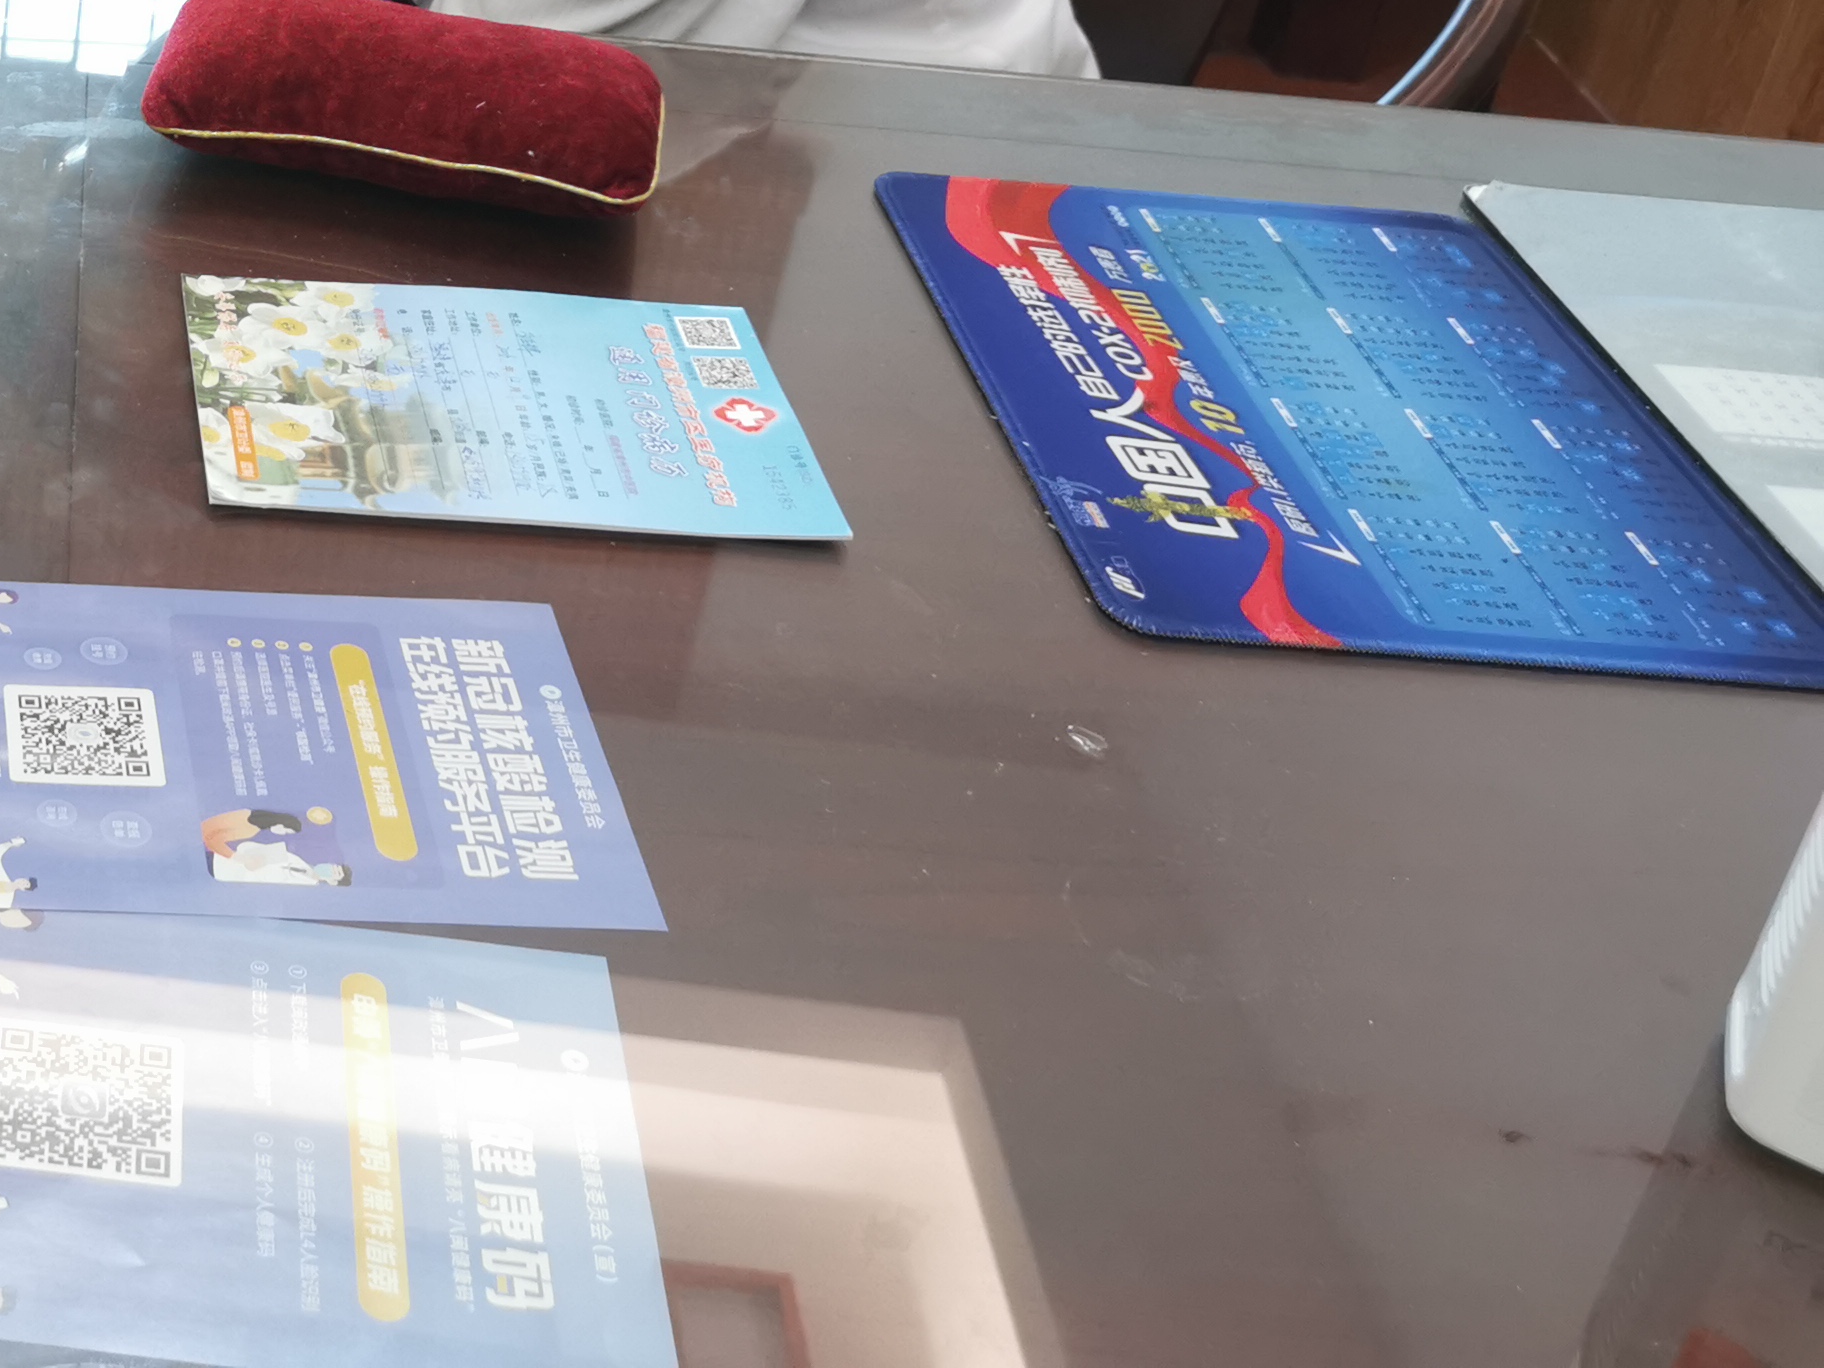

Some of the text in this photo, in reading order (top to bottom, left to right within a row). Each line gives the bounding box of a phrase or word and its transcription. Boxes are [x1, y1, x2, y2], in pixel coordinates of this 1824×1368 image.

[993, 263, 1121, 399] 自己的选择性
[1027, 245, 1156, 380] COX-2抑制剂
[1110, 288, 1186, 349] 2000
[1124, 248, 1167, 281] 2021
[604, 345, 691, 478] 通用门诊病历
[1089, 386, 1240, 538] 中国人
[1185, 398, 1245, 434] 10
[397, 635, 515, 878] 在线预约服务平台
[450, 638, 579, 880] 新冠核酸检测
[543, 700, 607, 829] 漳州市卫生健康委员会
[454, 1000, 556, 1311] 八健康码
